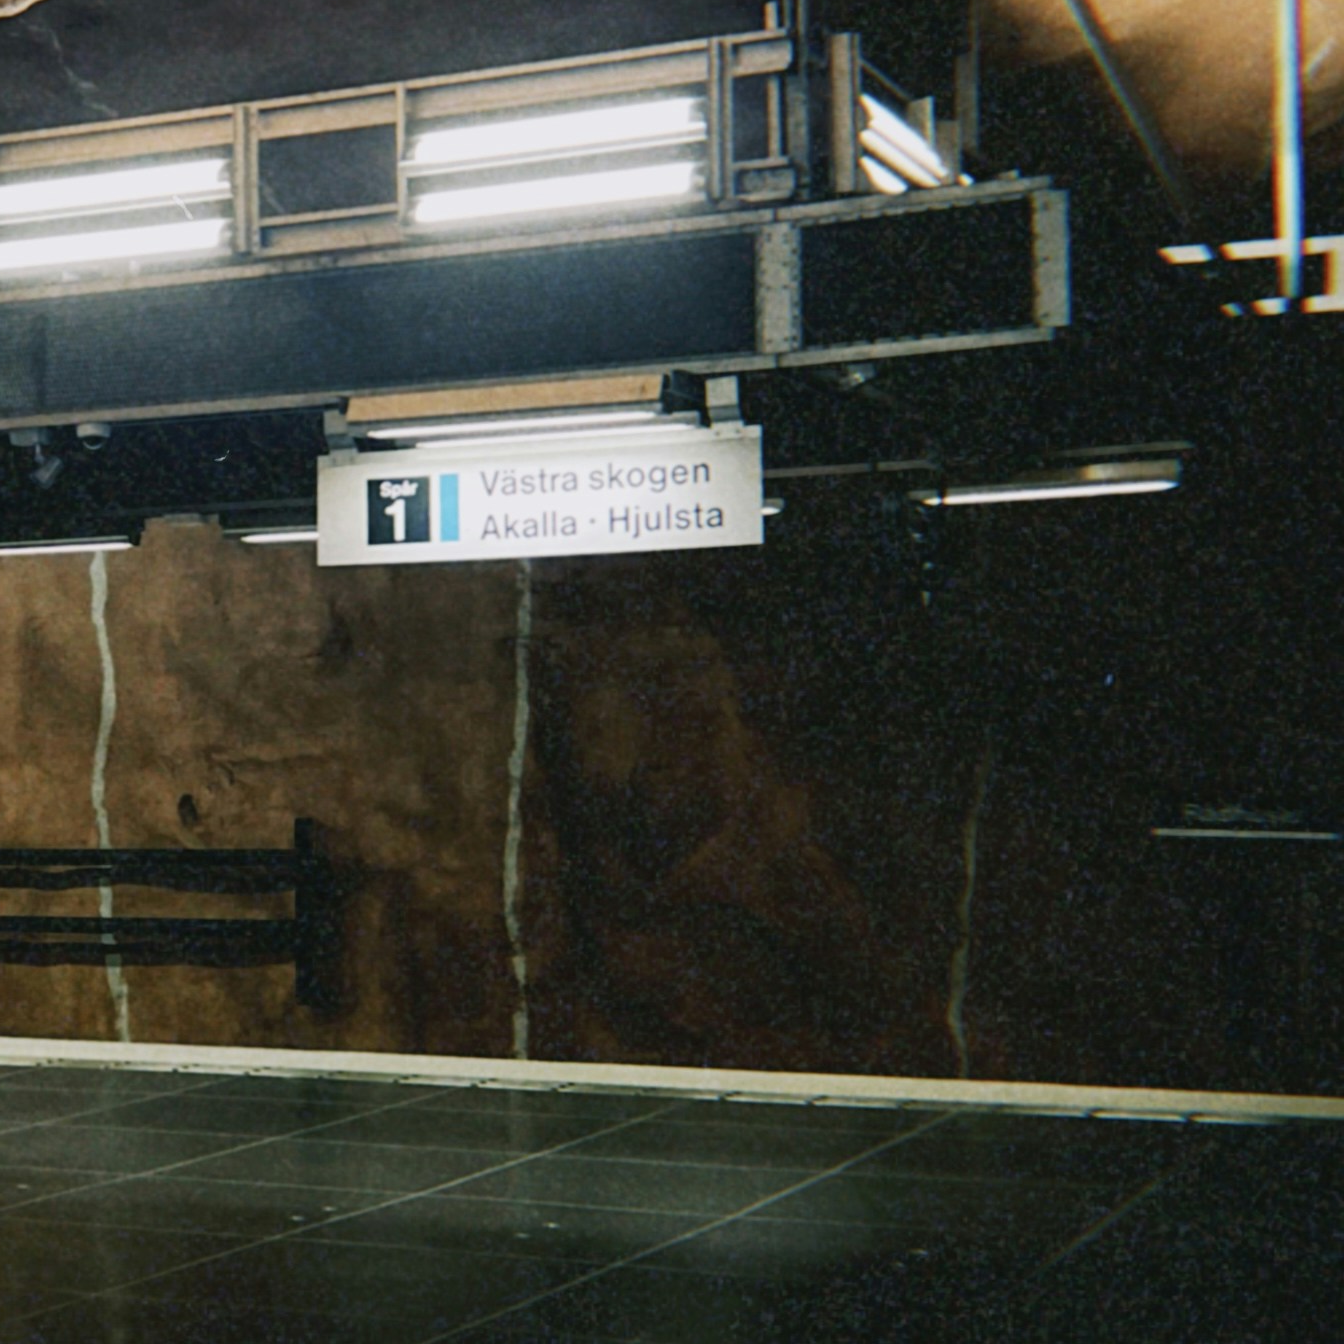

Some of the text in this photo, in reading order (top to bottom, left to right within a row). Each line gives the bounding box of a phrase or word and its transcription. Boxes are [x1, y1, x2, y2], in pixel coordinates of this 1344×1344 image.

[379, 479, 418, 499] Spår
[480, 462, 711, 497] Västra skogen
[384, 498, 406, 542] 1
[480, 511, 578, 540] Akalla
[608, 503, 724, 539] Hjulsta
